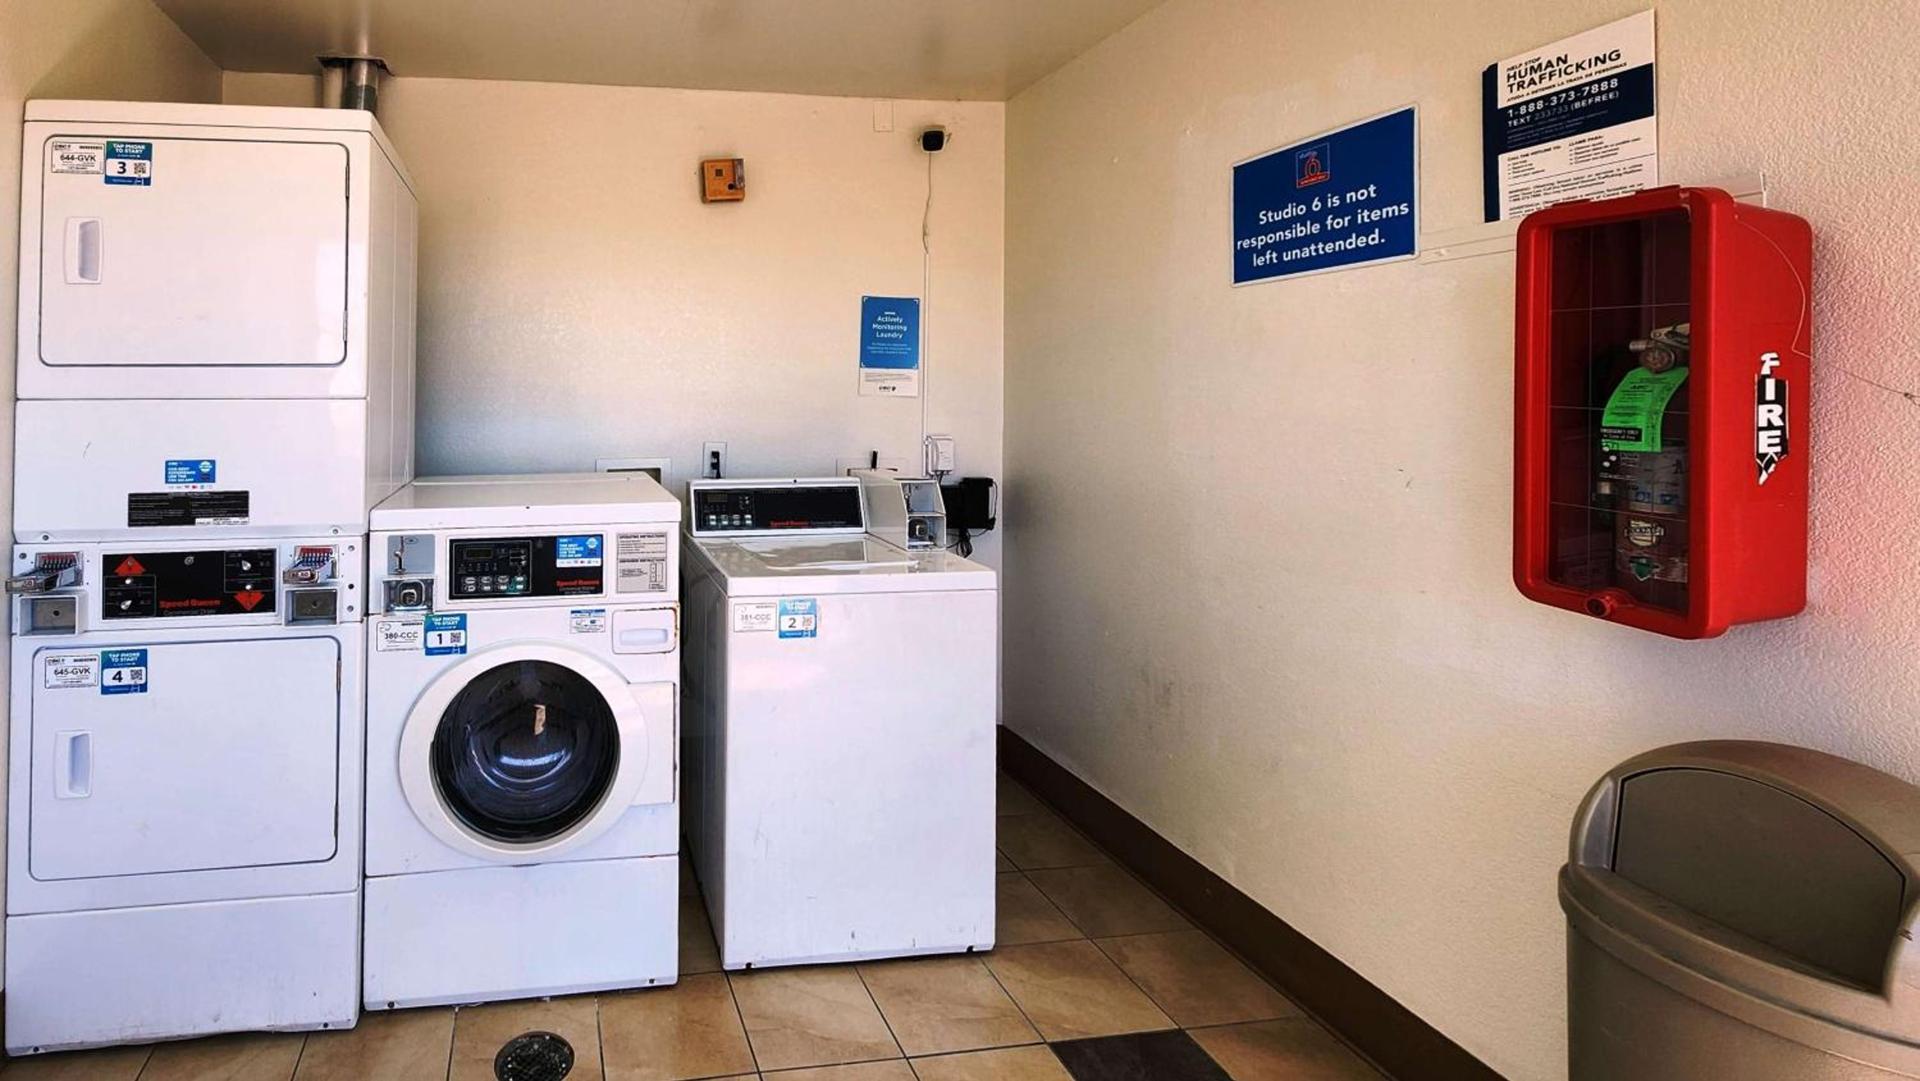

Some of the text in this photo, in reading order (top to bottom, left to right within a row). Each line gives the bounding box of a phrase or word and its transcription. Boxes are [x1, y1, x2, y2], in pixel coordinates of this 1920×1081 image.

[1506, 57, 1541, 73] HELP STOP
[1506, 53, 1569, 83] HUMAN
[1507, 49, 1622, 94] TRAFFICKING
[1594, 62, 1627, 75] PERSONAS
[1507, 78, 1619, 119] 1-888-373-7888
[1507, 115, 1531, 128] TEXT
[1534, 105, 1569, 120] 233733
[1570, 90, 1620, 112] (BEFREE)
[117, 161, 127, 174] 3
[1258, 184, 1377, 225] Studio 6 is not
[1236, 203, 1410, 250] responsible for items
[1252, 228, 1386, 267] left unattended.
[876, 316, 903, 324] Actively
[872, 323, 907, 332] Monitoring
[876, 331, 903, 339] Laundry
[1757, 352, 1785, 454] FIRE
[159, 598, 221, 609] Speed Queen
[788, 617, 797, 628] 2
[384, 631, 419, 640] 380-CCC
[436, 633, 443, 645] 1
[54, 667, 91, 675] 645-GVK
[112, 670, 123, 683] 4
